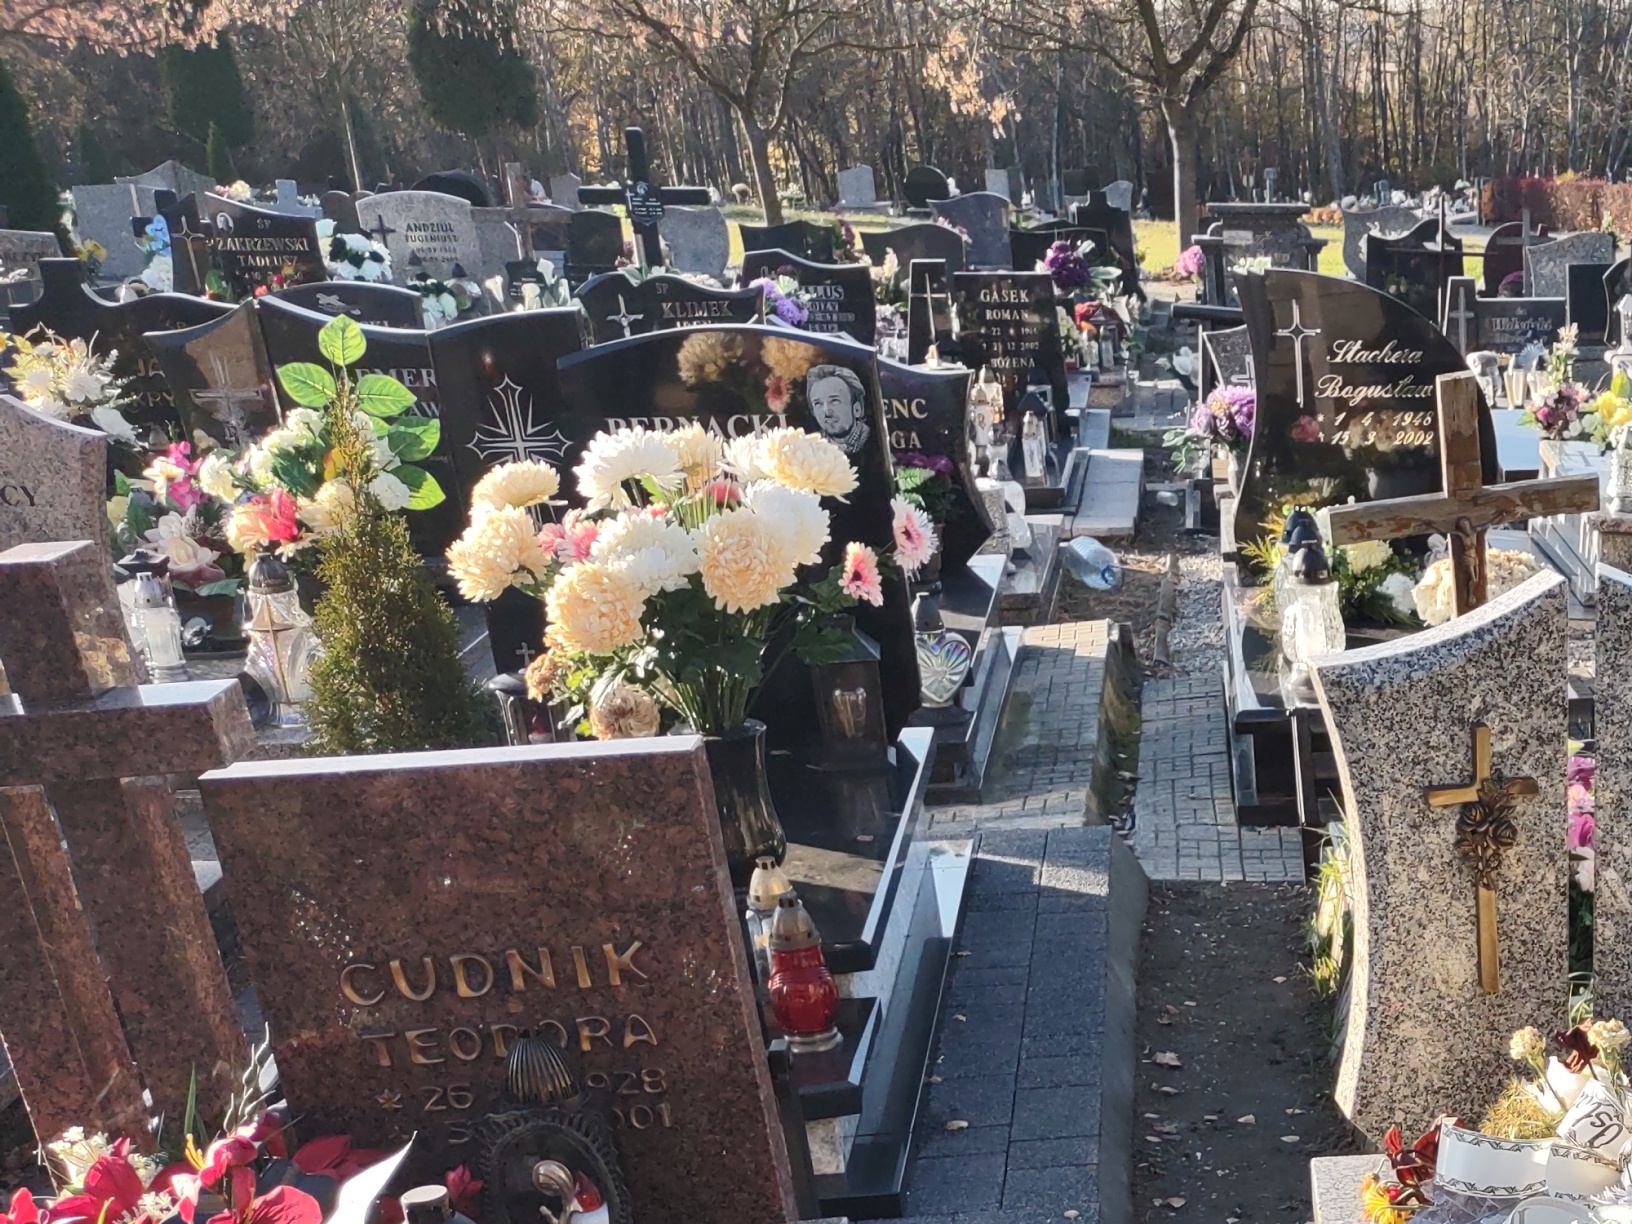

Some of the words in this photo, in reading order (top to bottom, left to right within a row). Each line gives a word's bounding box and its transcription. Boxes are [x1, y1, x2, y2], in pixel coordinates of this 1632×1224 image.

[217, 237, 310, 251] ZAKRZEWSKI
[660, 301, 733, 319] KLIMEK
[985, 309, 1029, 321] ROMAN
[1326, 339, 1424, 364] Stachera
[1313, 375, 1435, 407] Bogusław
[1392, 410, 1435, 427] 1948
[1330, 431, 1350, 446] 15
[1393, 431, 1436, 446] 2002
[339, 940, 650, 1007] CUDNIK
[419, 1082, 475, 1112] 26
